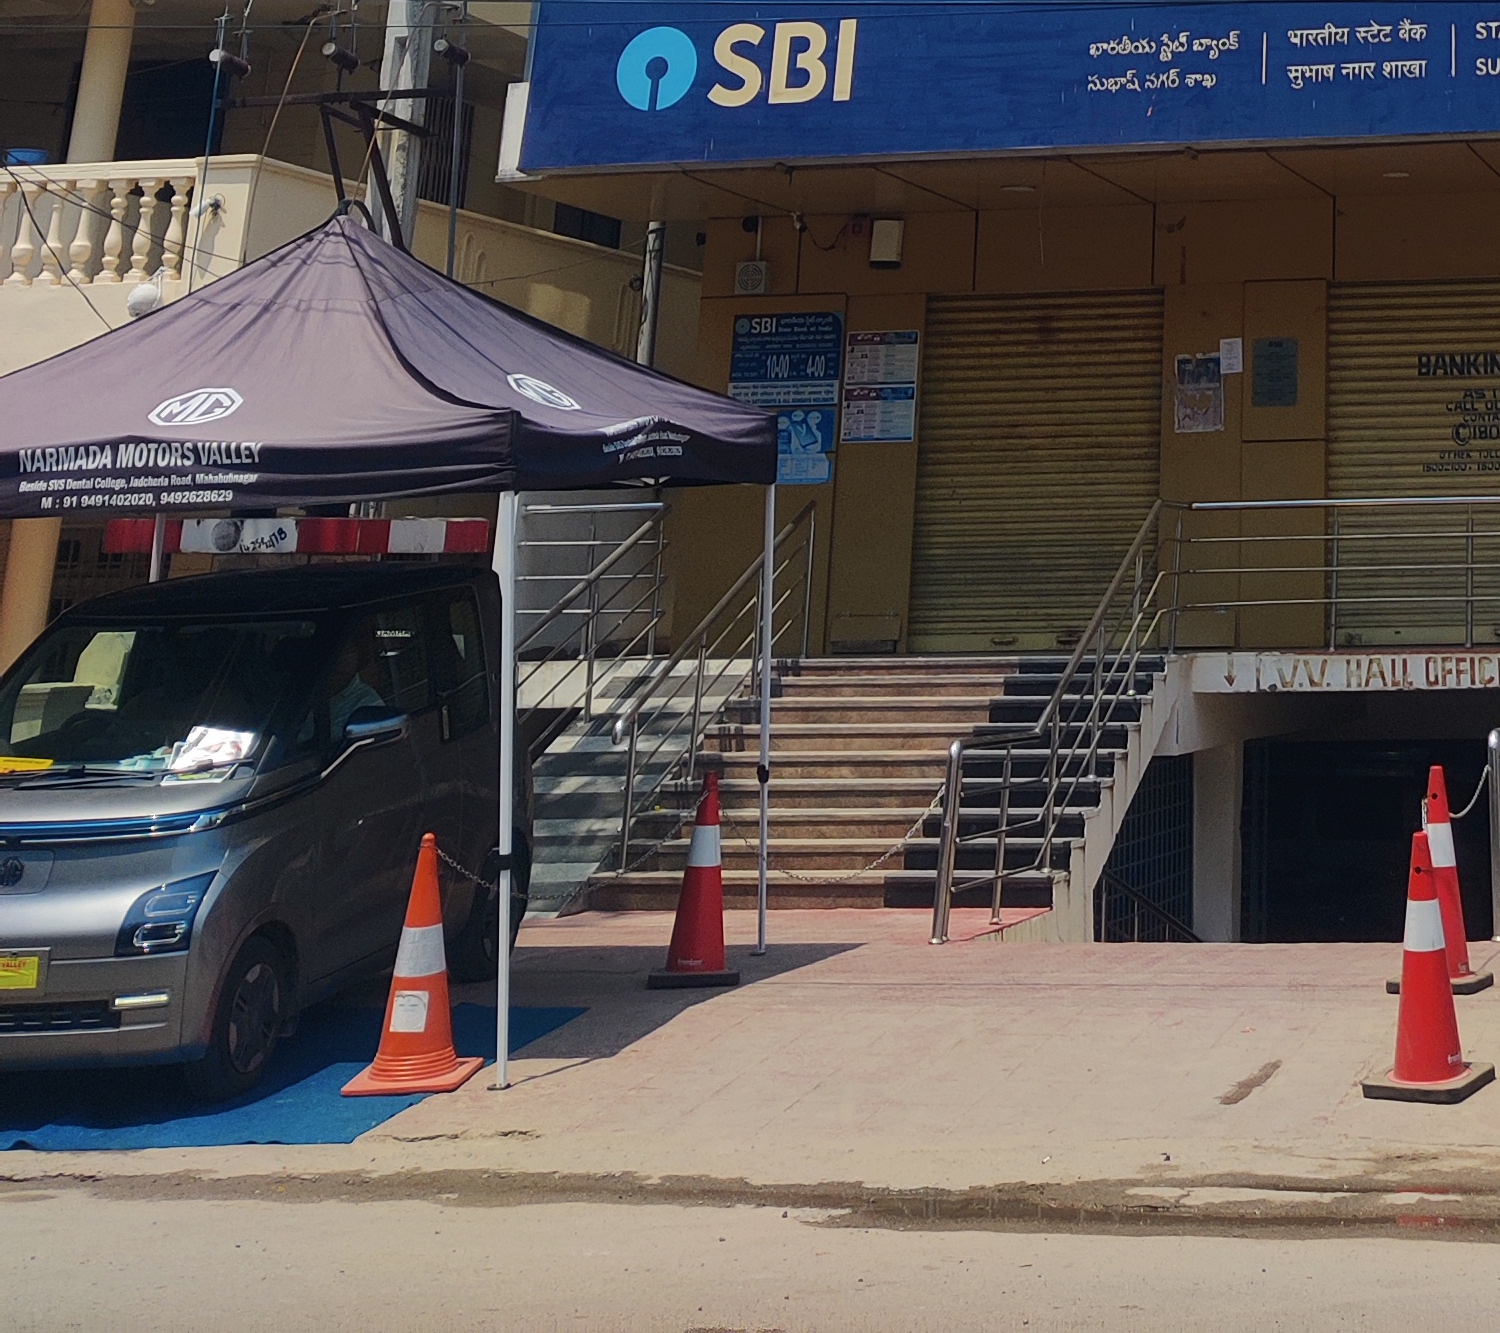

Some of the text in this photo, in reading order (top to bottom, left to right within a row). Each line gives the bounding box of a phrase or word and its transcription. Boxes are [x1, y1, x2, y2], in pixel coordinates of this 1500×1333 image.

[1089, 30, 1240, 61] భారతీయ స్టేట్ బ్యాంక్
[1287, 18, 1427, 48] भारतीय स्टेट बैंक
[707, 18, 857, 107] SBI
[1287, 60, 1427, 89] सुभाष नगर शाखा
[1087, 69, 1216, 93] సుభాష్ నగర్ శాఖ
[751, 317, 777, 333] SBI
[154, 391, 238, 424] MG
[1446, 400, 1478, 412] CALL
[1463, 388, 1486, 400] AS
[19, 442, 262, 473] NARMADA MOTORS VALLEY
[19, 480, 47, 492] Beside
[48, 479, 65, 491] SVS
[66, 478, 93, 490] Dental
[95, 477, 127, 490] College,
[170, 474, 193, 487] Road,
[41, 496, 52, 509] M
[63, 496, 77, 508] 91
[81, 493, 155, 507] 9491402020,
[160, 490, 233, 504] 9492628629
[1346, 657, 1413, 687] HALL
